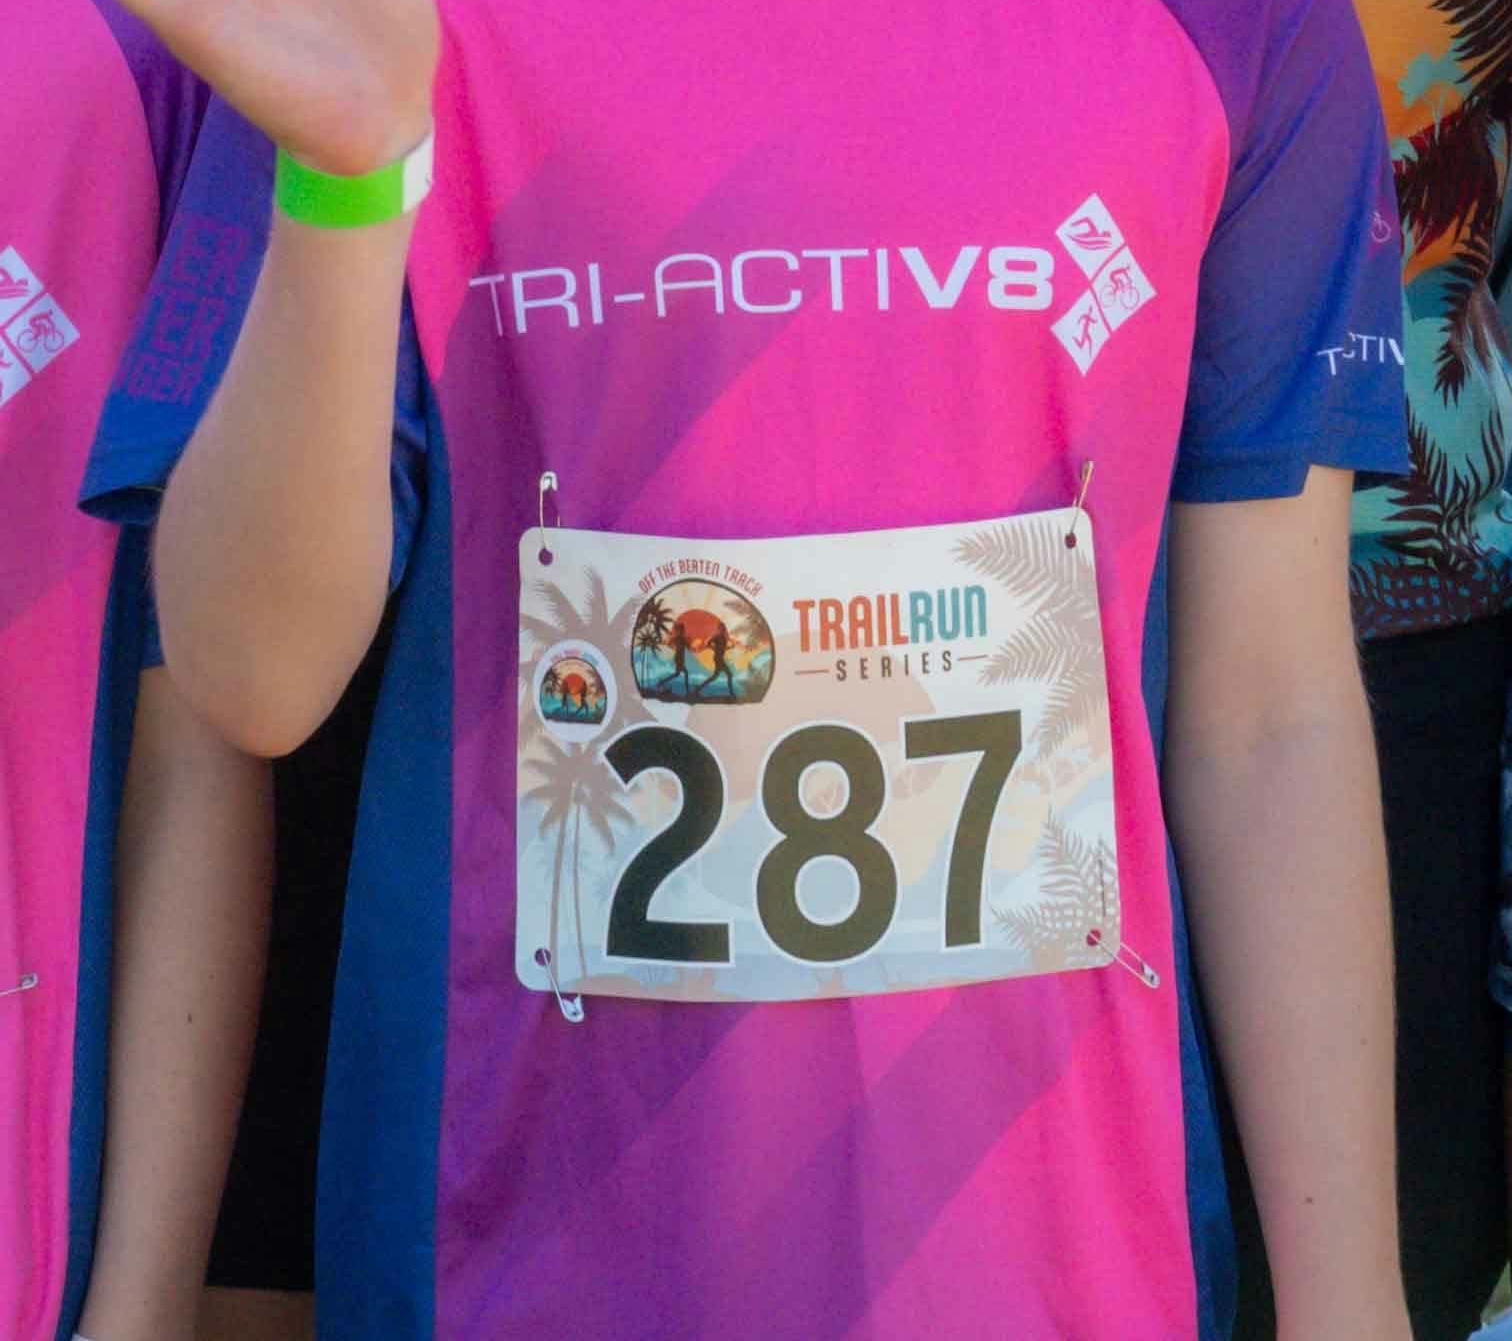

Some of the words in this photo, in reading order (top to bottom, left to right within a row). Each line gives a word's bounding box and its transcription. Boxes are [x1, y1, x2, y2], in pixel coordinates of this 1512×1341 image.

[467, 245, 1056, 338] TRI-ACTIV8
[638, 570, 658, 596] OFF
[656, 560, 678, 580] THE
[678, 556, 722, 577] BEATEN
[724, 561, 766, 599] TRACK
[792, 583, 989, 653] TRAILRUN
[835, 648, 955, 683] SERIES
[604, 709, 1024, 966] 287
